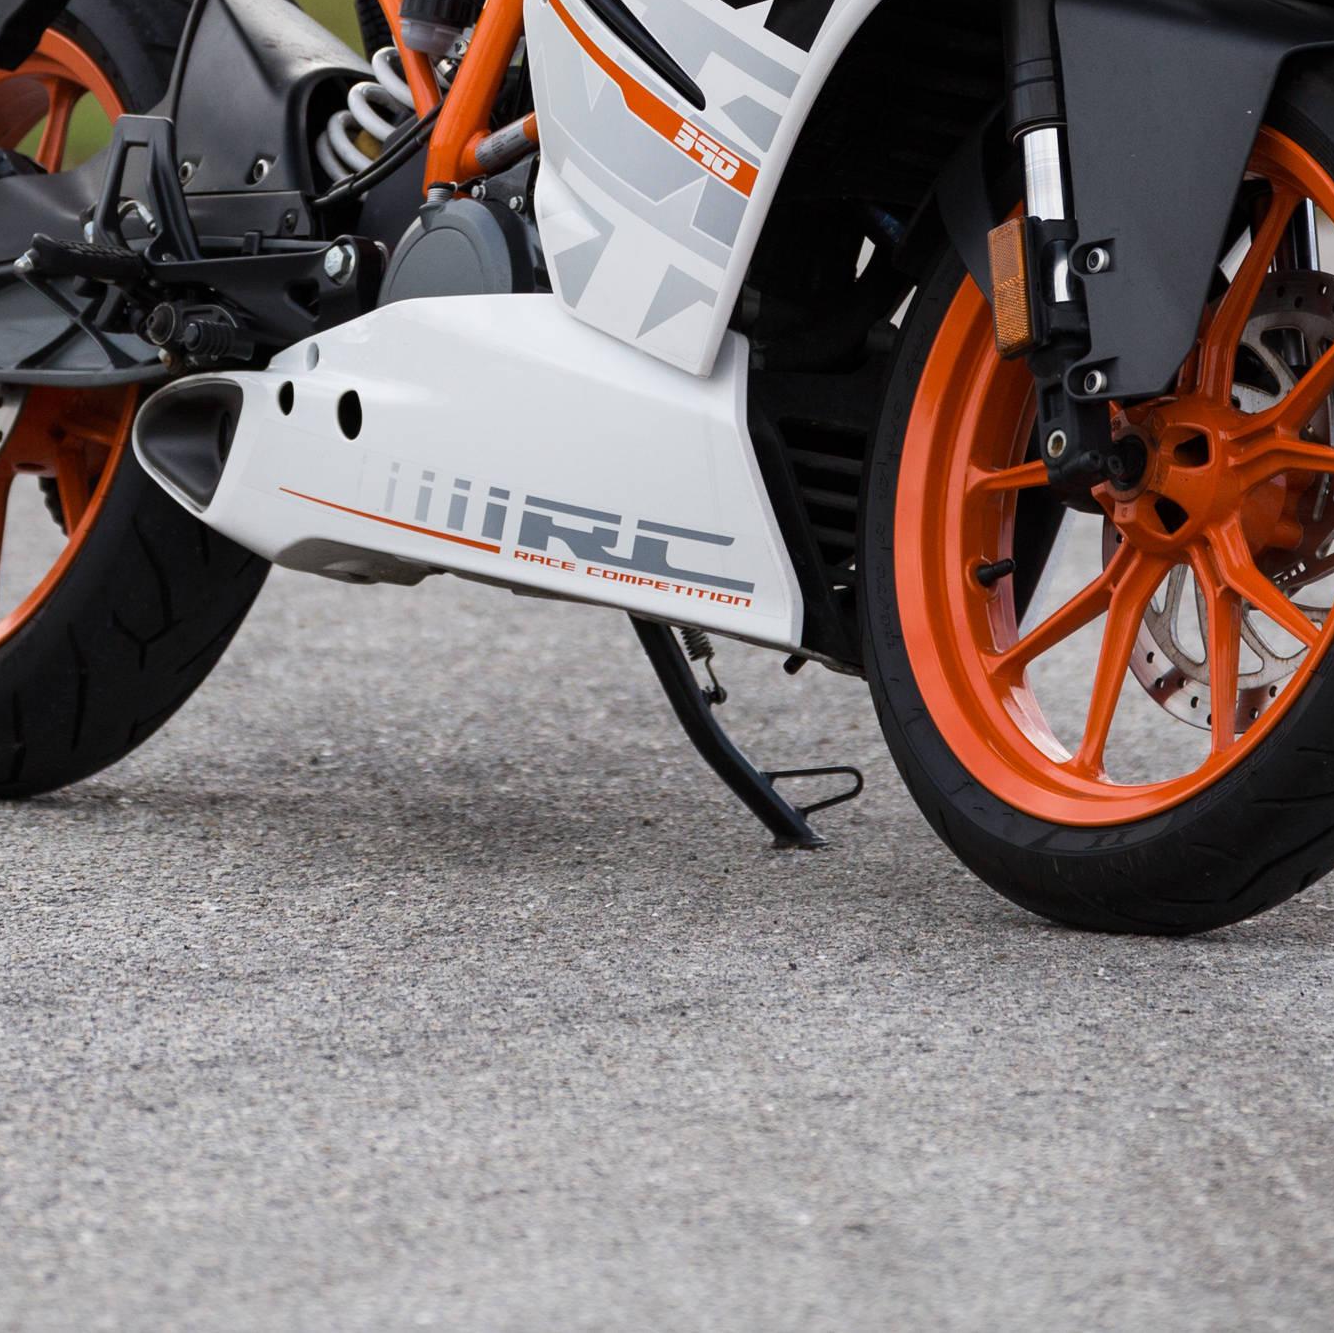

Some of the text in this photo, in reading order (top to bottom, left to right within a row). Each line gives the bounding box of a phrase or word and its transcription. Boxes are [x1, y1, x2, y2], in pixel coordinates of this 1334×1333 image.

[673, 121, 741, 182] 390
[519, 495, 755, 594] RC
[514, 550, 752, 608] RACE COMPETITION
